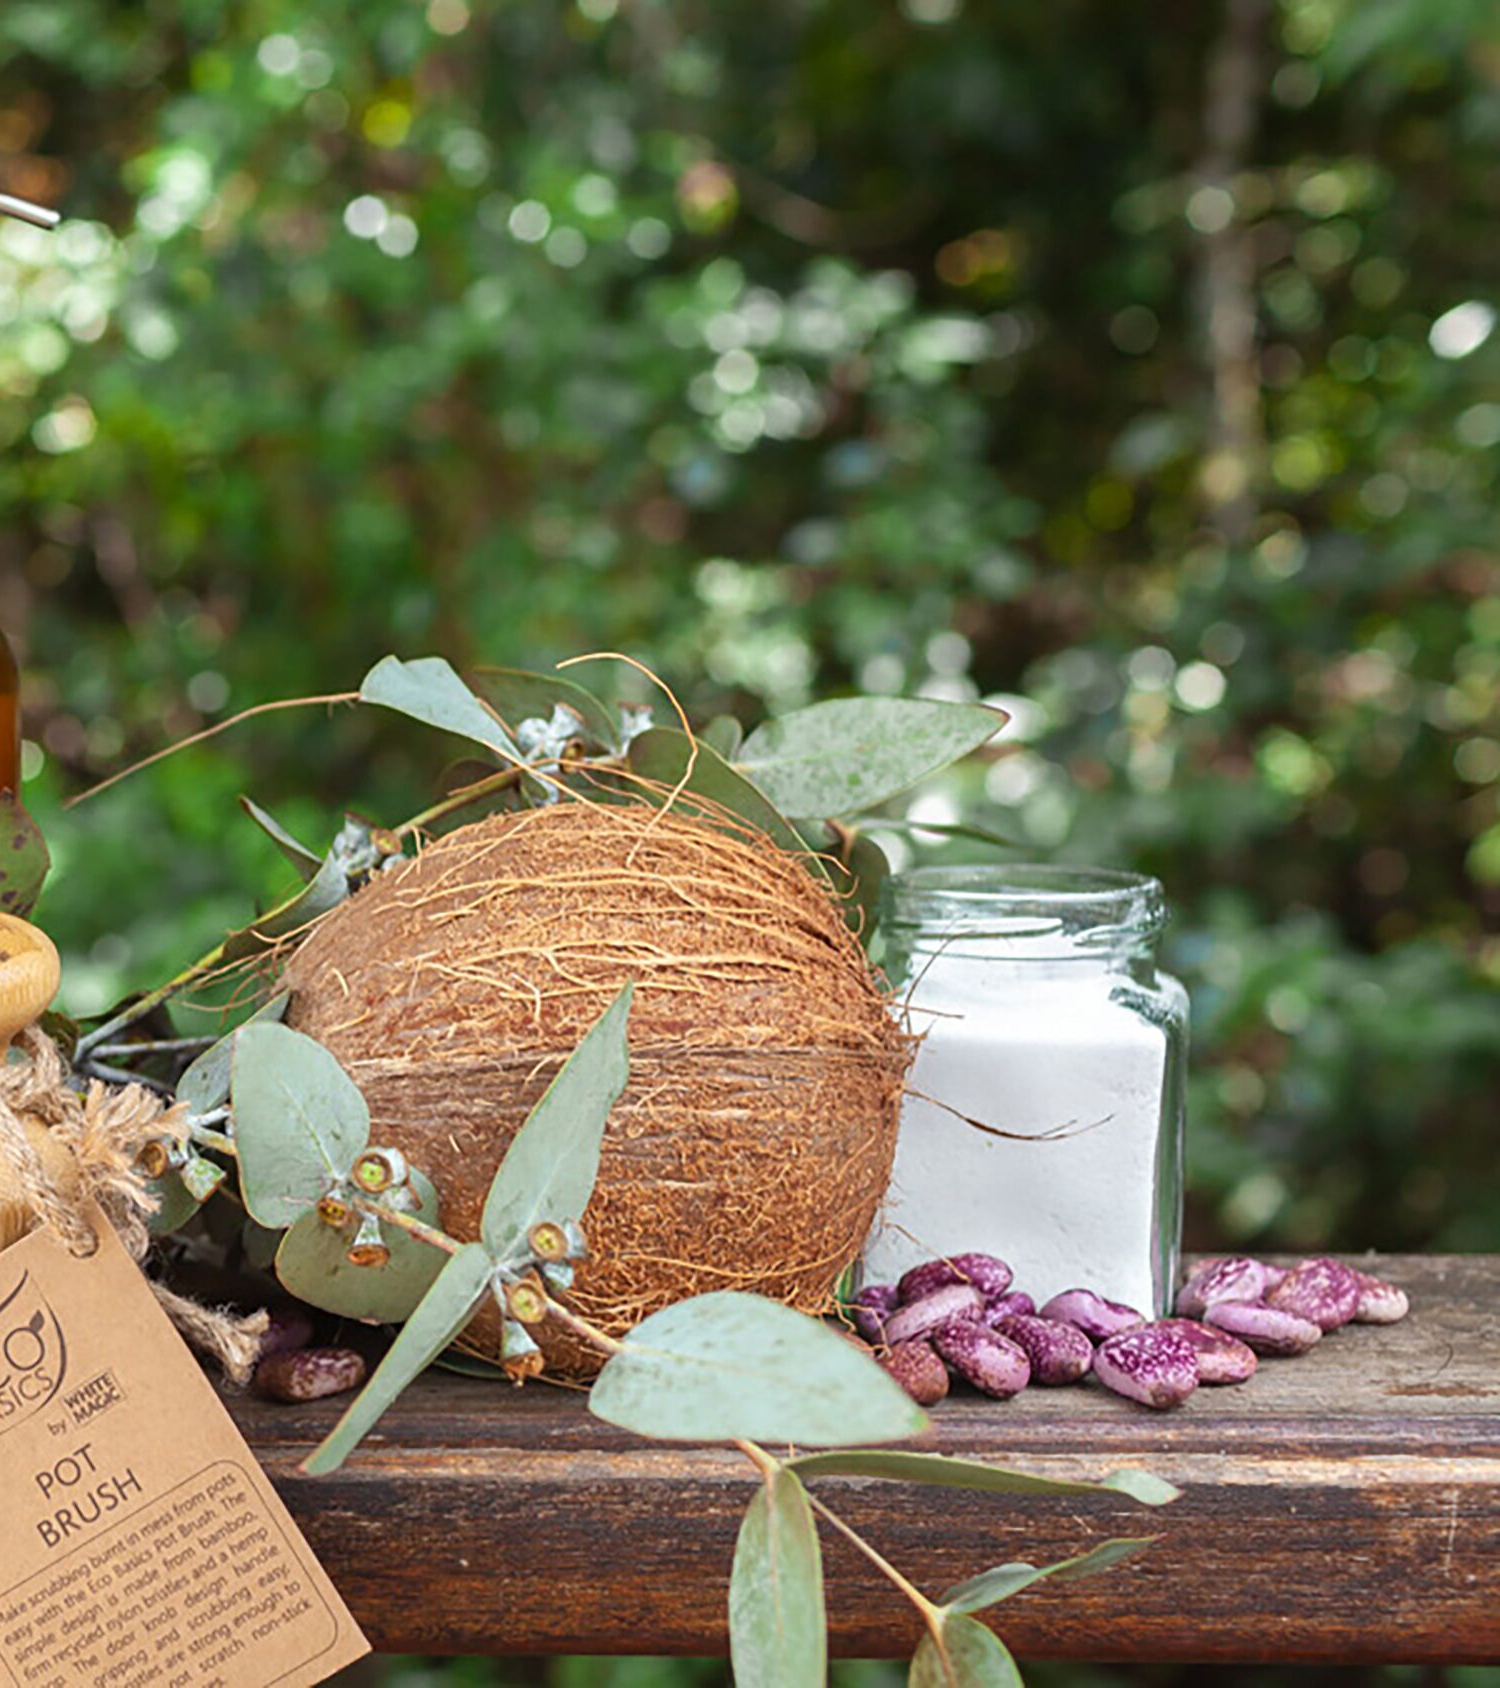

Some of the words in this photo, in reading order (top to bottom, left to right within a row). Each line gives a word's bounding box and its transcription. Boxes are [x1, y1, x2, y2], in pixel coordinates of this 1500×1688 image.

[47, 1419, 66, 1436] by
[64, 1373, 112, 1408] WHITE
[73, 1386, 120, 1423] MAGIC
[35, 1443, 95, 1499] POT
[37, 1468, 141, 1547] BRUSH
[4, 1622, 33, 1645] easy
[34, 1604, 63, 1626] with
[63, 1590, 86, 1608] the
[86, 1574, 112, 1594] Eco
[112, 1549, 153, 1578] Basics
[153, 1532, 178, 1553] Pot
[220, 1492, 246, 1511] The
[28, 1564, 91, 1607] scrubbing
[88, 1540, 127, 1569] burnt
[140, 1512, 173, 1536] mess
[172, 1492, 206, 1517] from
[206, 1473, 236, 1500] pots
[14, 1632, 56, 1664] simple
[60, 1604, 103, 1635] design
[123, 1569, 160, 1597] made
[162, 1546, 196, 1572] from
[52, 1624, 105, 1664] recycled
[105, 1604, 143, 1631] nylon
[141, 1575, 190, 1608] bristles
[192, 1555, 217, 1580] and
[227, 1527, 268, 1556] hemp
[72, 1654, 99, 1674] The
[106, 1631, 136, 1656] door
[141, 1606, 177, 1632] knob
[183, 1576, 228, 1608] design
[232, 1545, 279, 1577] handle
[155, 1627, 180, 1651] and
[187, 1586, 252, 1630] scrubbing
[165, 1651, 185, 1669] are
[187, 1624, 232, 1654] strong
[233, 1591, 283, 1628] enough
[199, 1639, 245, 1672] scratch
[251, 1598, 312, 1640] non-stick
